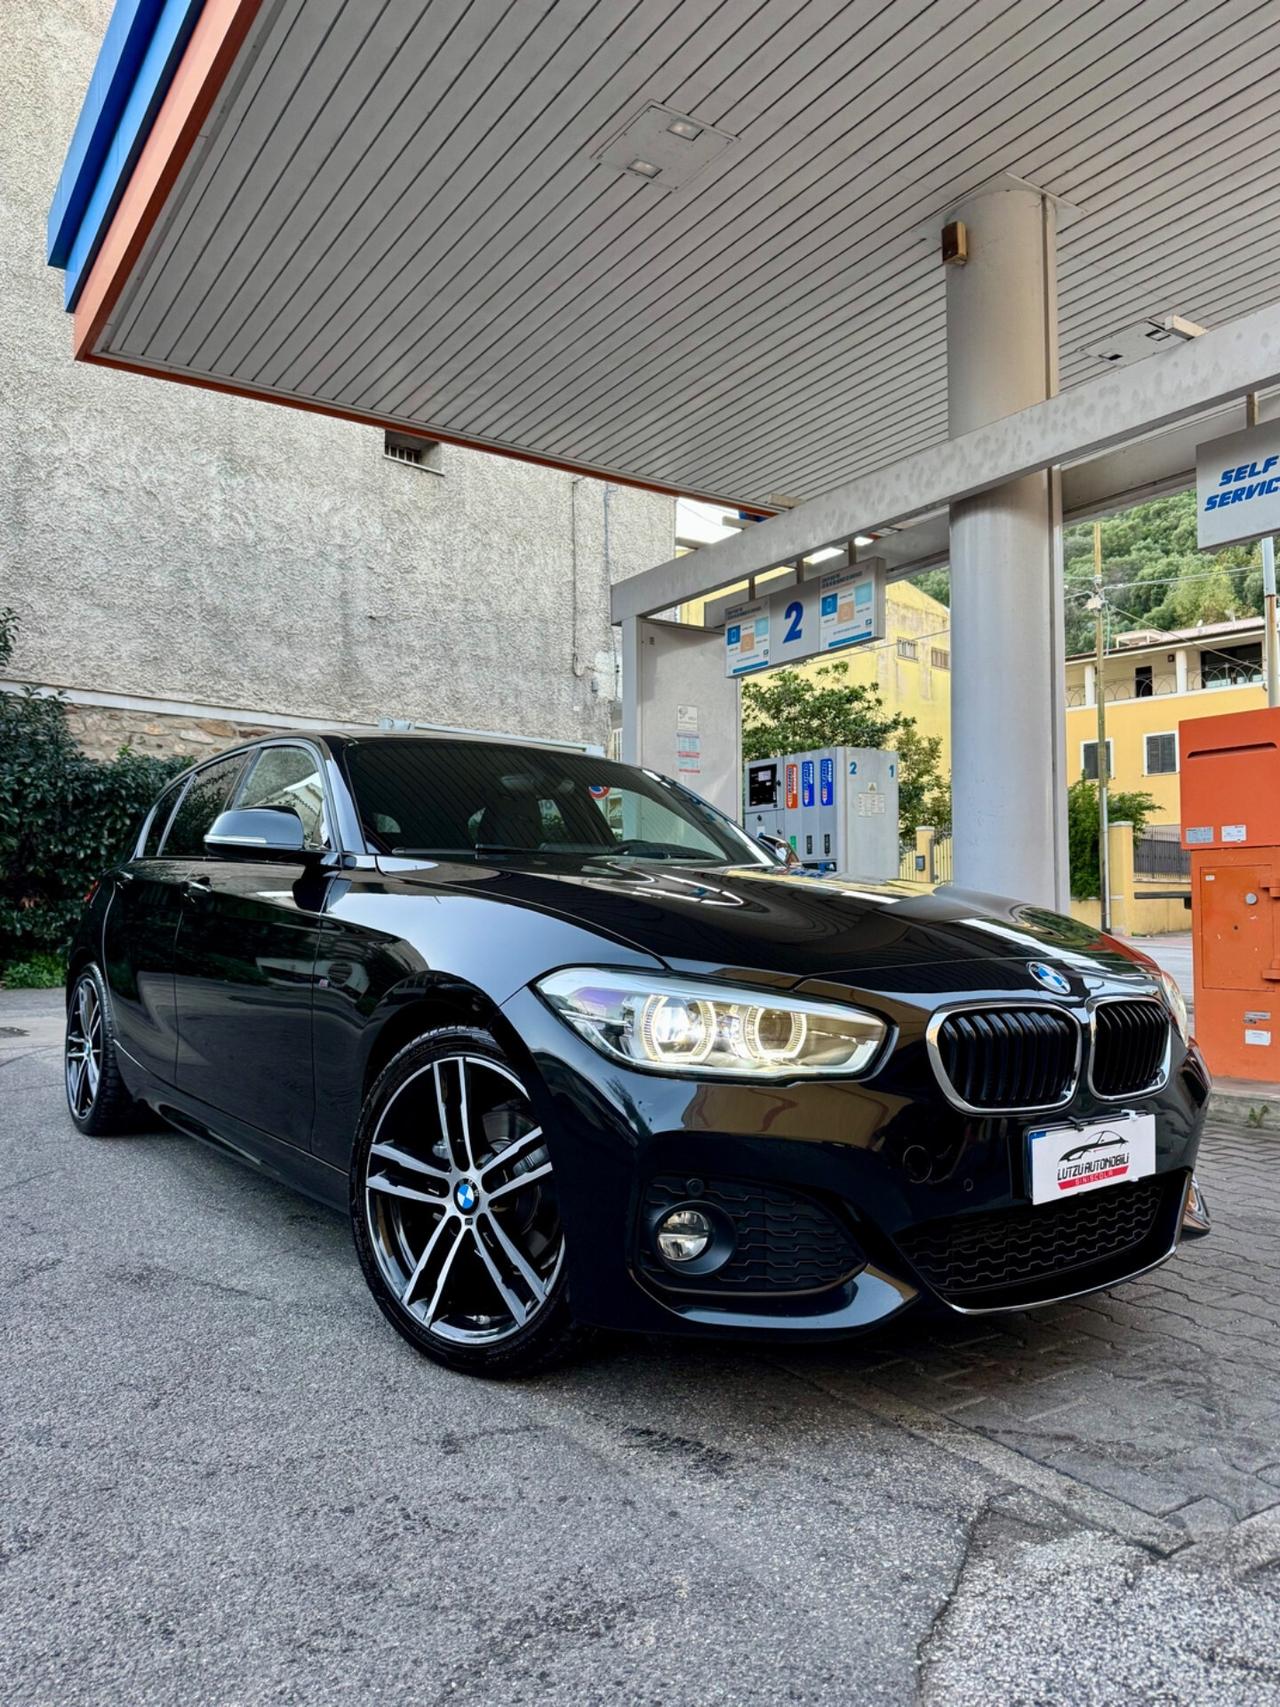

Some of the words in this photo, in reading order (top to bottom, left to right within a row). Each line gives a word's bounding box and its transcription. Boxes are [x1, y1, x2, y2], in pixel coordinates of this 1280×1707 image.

[1219, 455, 1279, 487] SELF
[1204, 476, 1280, 512] SERVIC
[782, 601, 804, 644] 2
[849, 761, 857, 775] 2
[889, 764, 895, 778] 1
[1057, 1163, 1084, 1180] LUTZU
[1084, 1152, 1130, 1174] AUTOMOBILI
